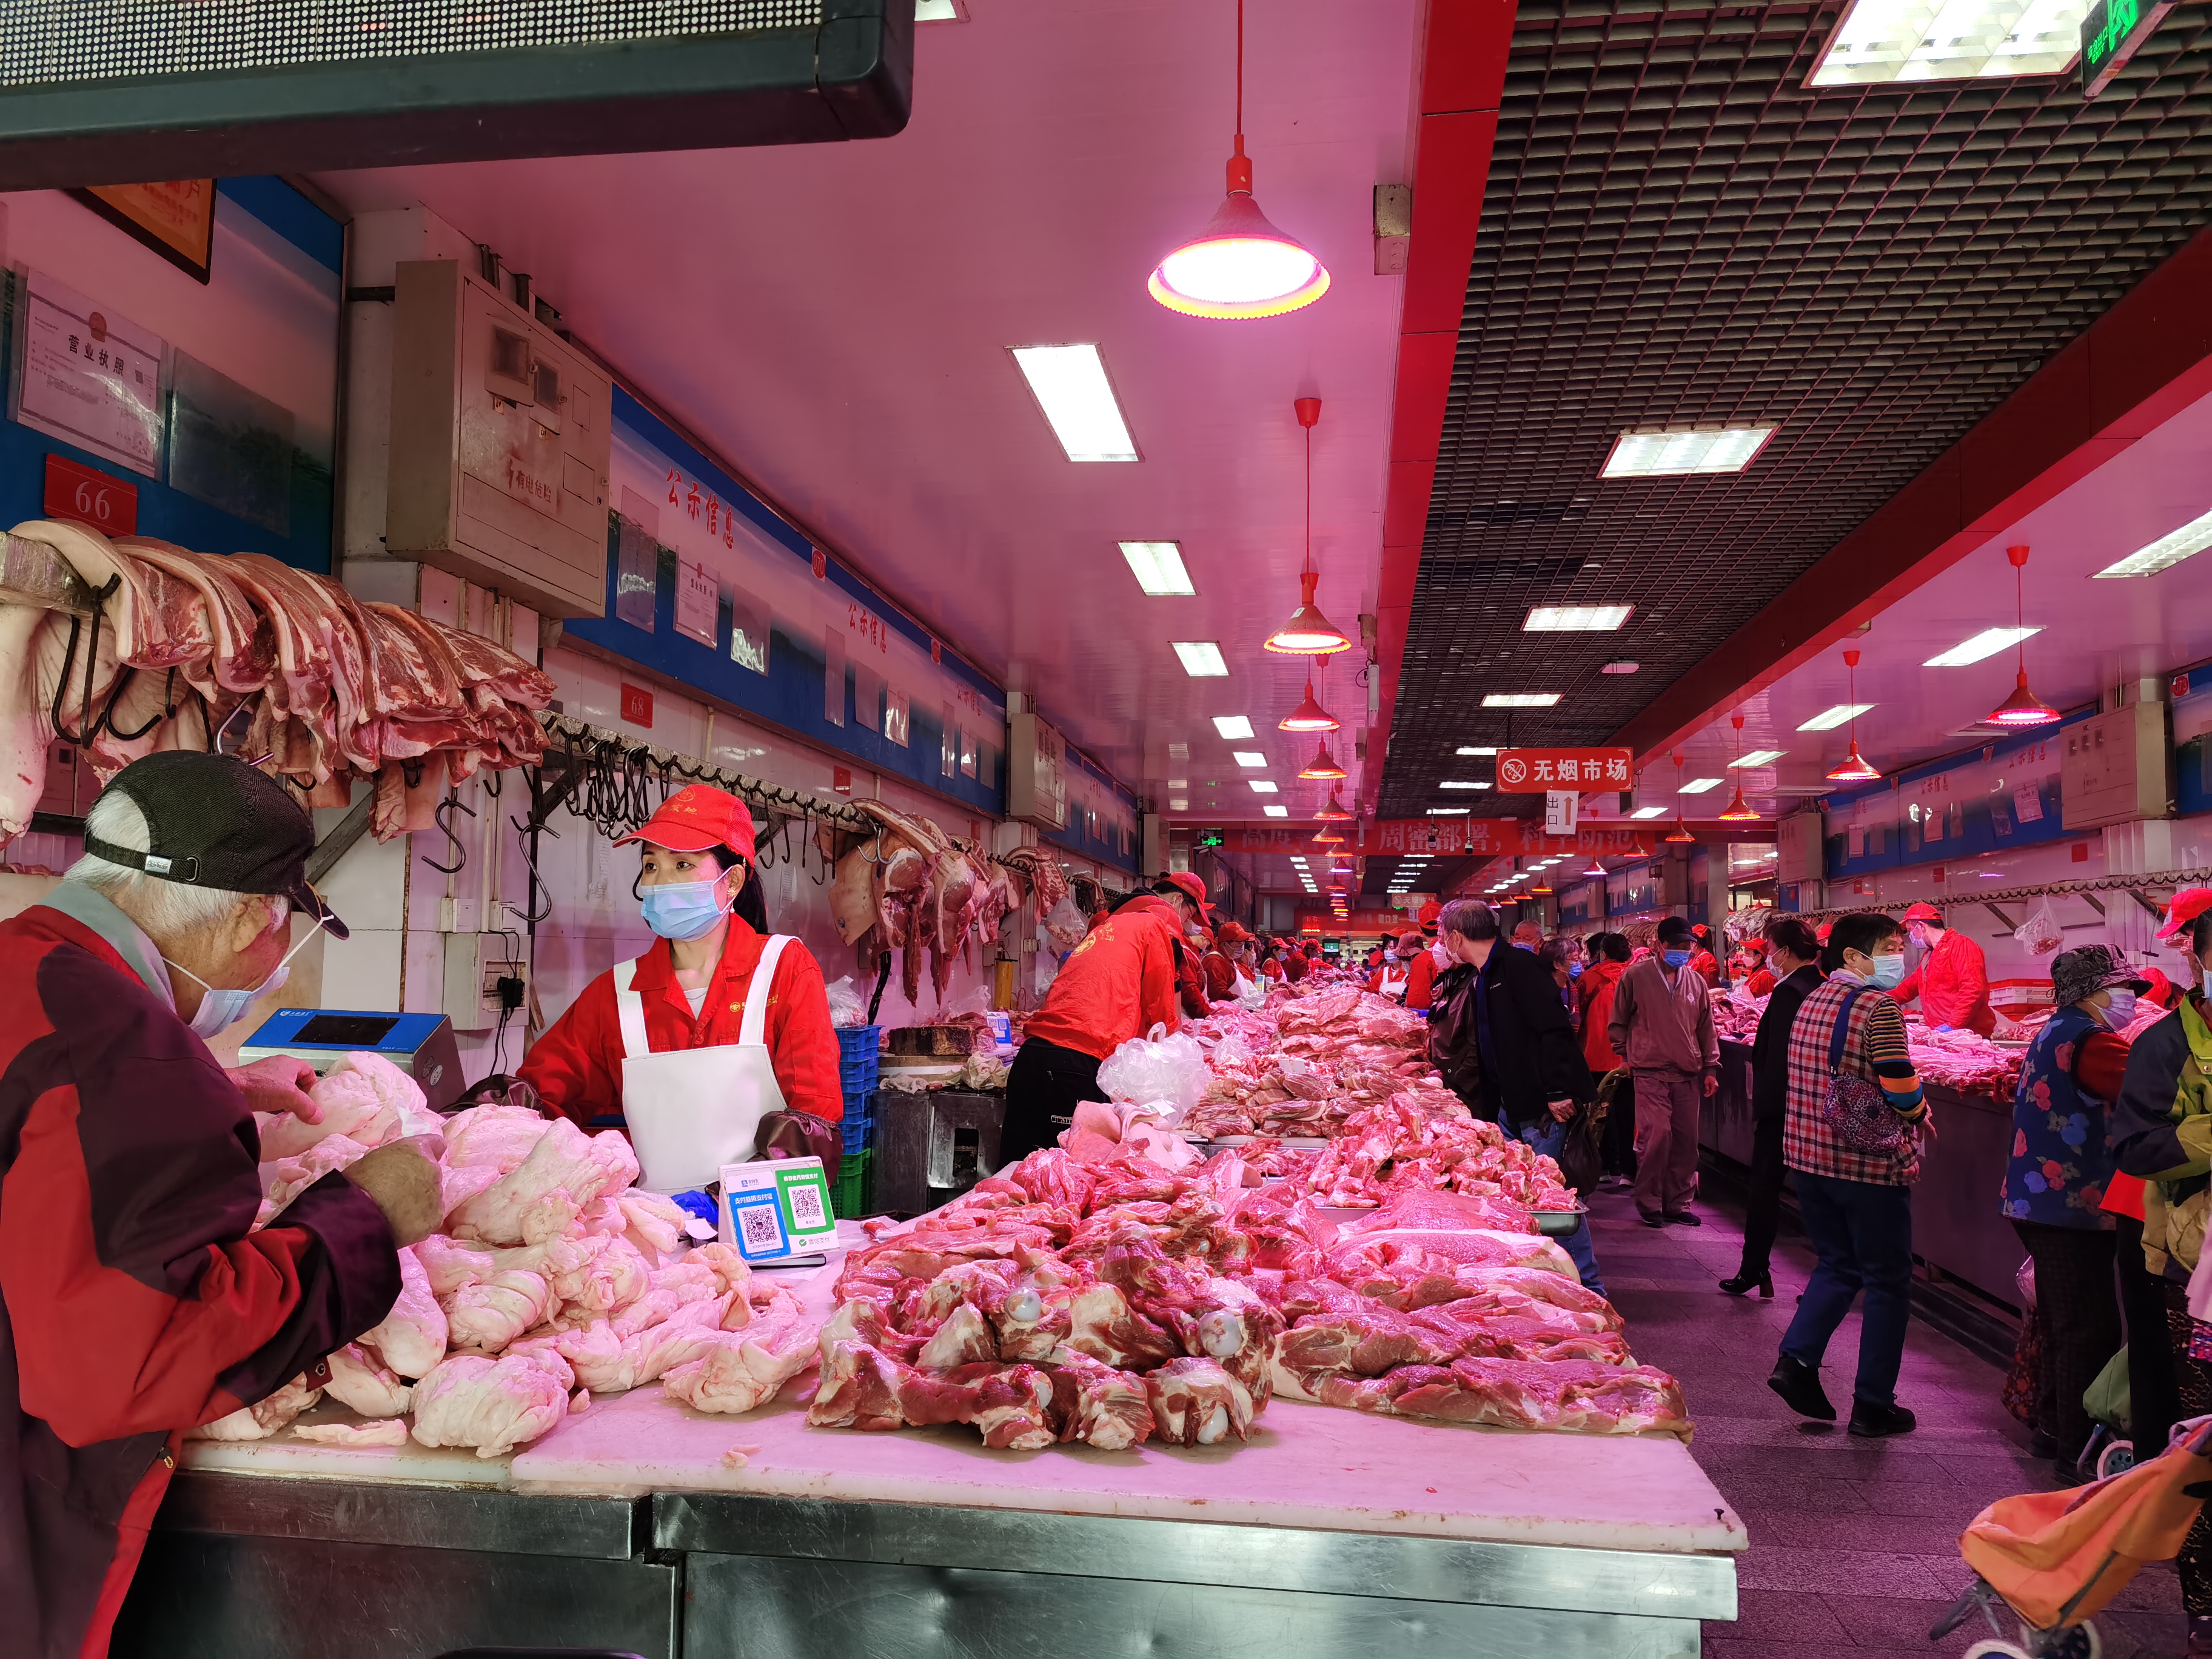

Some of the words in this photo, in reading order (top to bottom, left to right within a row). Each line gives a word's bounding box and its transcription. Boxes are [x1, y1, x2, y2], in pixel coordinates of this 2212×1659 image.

[68, 333, 125, 377] 营业执照
[75, 481, 110, 520] 66
[666, 465, 734, 549] 公示信息
[812, 554, 824, 575] 070
[848, 602, 886, 654] 公示信息
[631, 696, 643, 717] 68
[1533, 758, 1627, 782] 无烟市场
[1547, 796, 1559, 826] 出口
[808, 1236, 830, 1245] 微信支付
